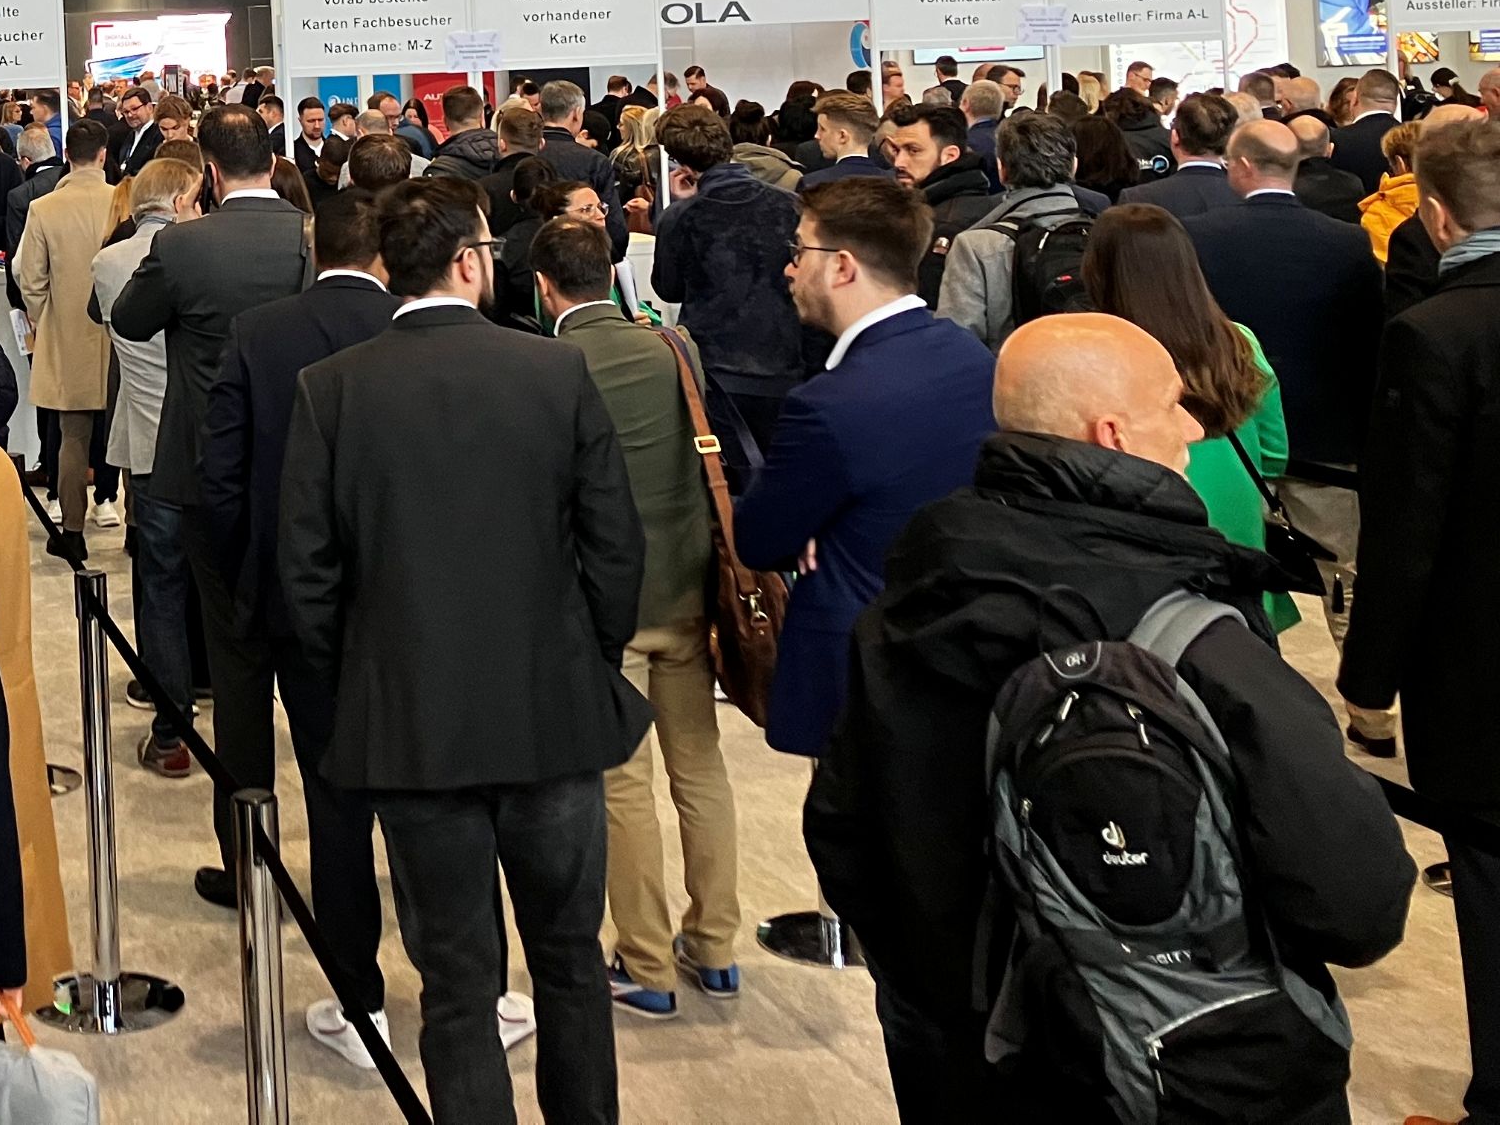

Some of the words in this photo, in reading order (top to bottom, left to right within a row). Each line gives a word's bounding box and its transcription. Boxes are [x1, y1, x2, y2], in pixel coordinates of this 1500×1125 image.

[523, 8, 612, 23] vorhandener
[660, 0, 752, 26] OLA
[944, 14, 980, 25] Karte
[1071, 11, 1142, 24] Aussteller:
[1146, 10, 1183, 21] Firma
[1187, 8, 1210, 19] A-L
[302, 18, 348, 31] Karten
[353, 15, 453, 29] Fachbesucher
[550, 32, 587, 45] Karte
[324, 41, 402, 54] Nachname:
[407, 39, 433, 52] M-Z
[1102, 849, 1149, 866] deuter
